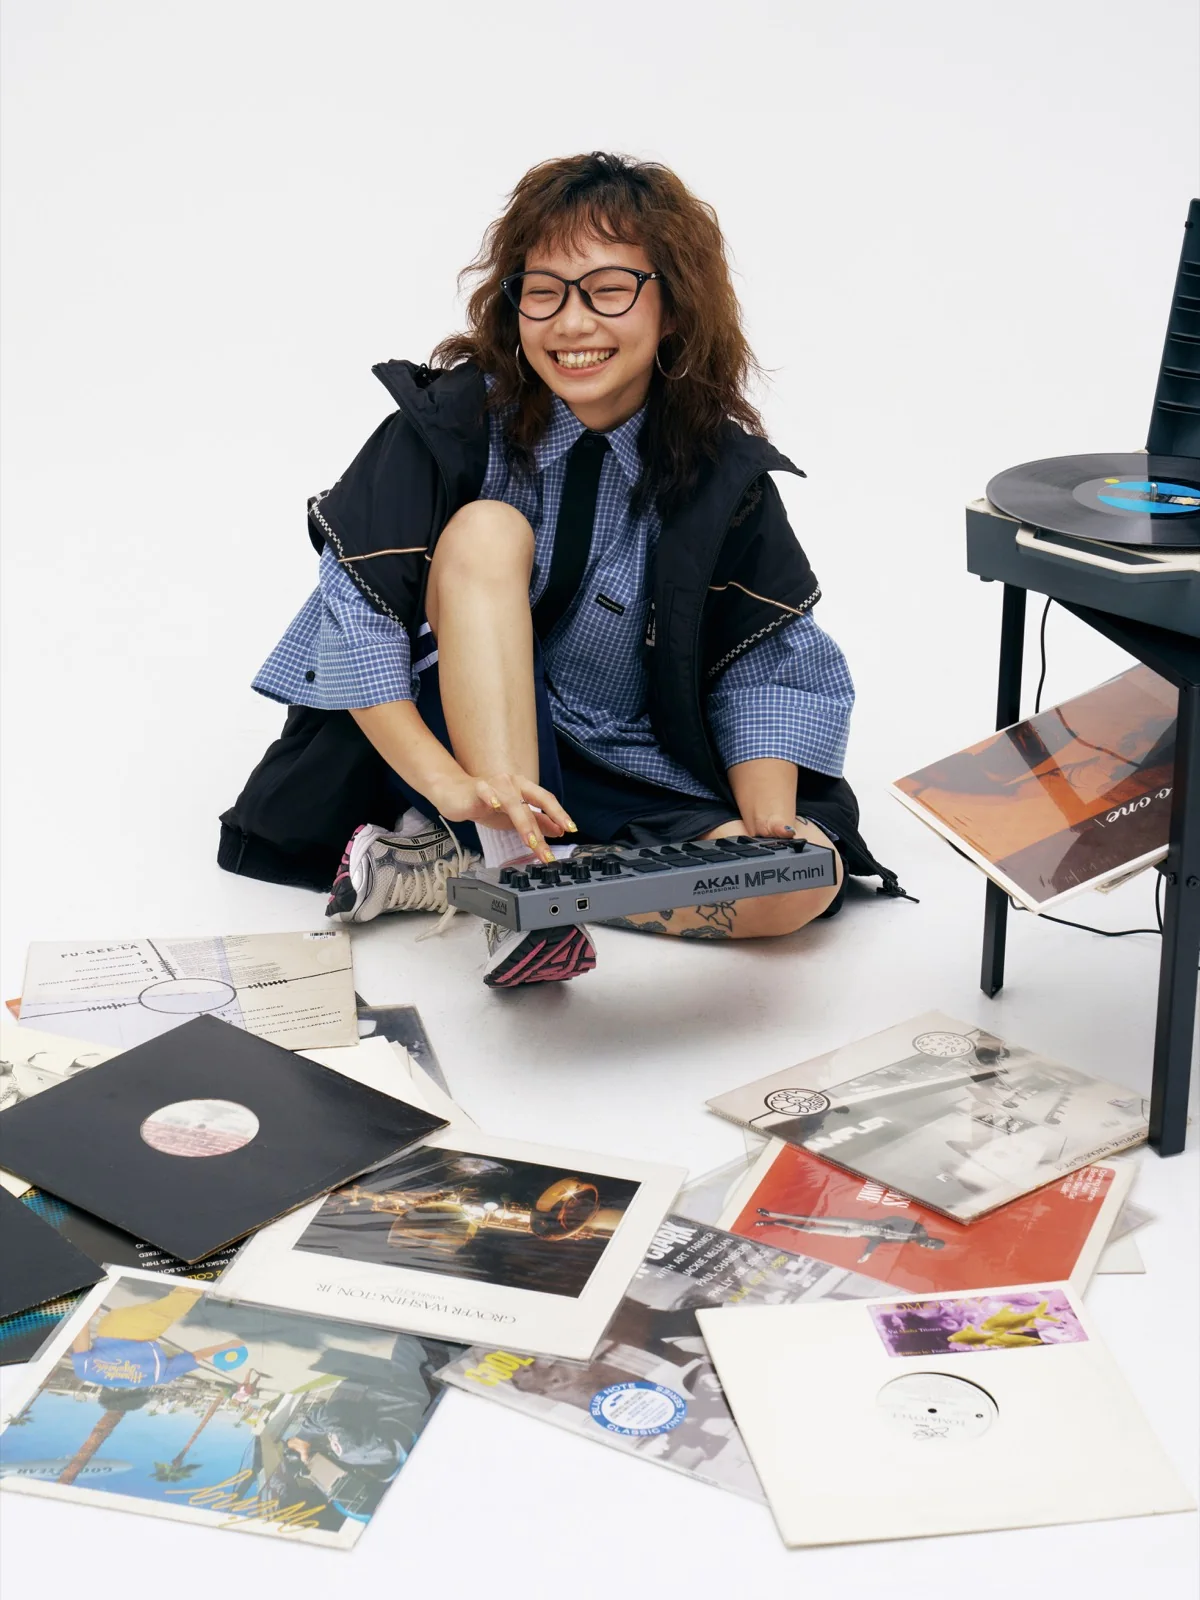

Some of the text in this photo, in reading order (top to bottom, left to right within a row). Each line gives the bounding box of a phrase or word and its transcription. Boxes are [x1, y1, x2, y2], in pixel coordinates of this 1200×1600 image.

[1105, 796, 1151, 823] one
[693, 864, 824, 891] AKAI MPK mini
[692, 885, 740, 896] PROFESSIONAL
[61, 943, 139, 959] FU-GEE-LA
[656, 1264, 677, 1279] WITH
[673, 1252, 690, 1265] ART
[687, 1232, 717, 1253] FARMER
[682, 1238, 734, 1277] JACKIE McLEAN
[696, 1271, 718, 1287] PAUL
[452, 1306, 517, 1324] GROVER
[464, 1350, 536, 1387] COOL
[592, 1395, 605, 1416] BLUE
[603, 1382, 637, 1396] NOTE
[655, 1386, 685, 1409] SERIES
[606, 1423, 661, 1436] CLASSIC
[661, 1410, 686, 1430] VINYL
[17, 1466, 113, 1477] GOOYEAR
